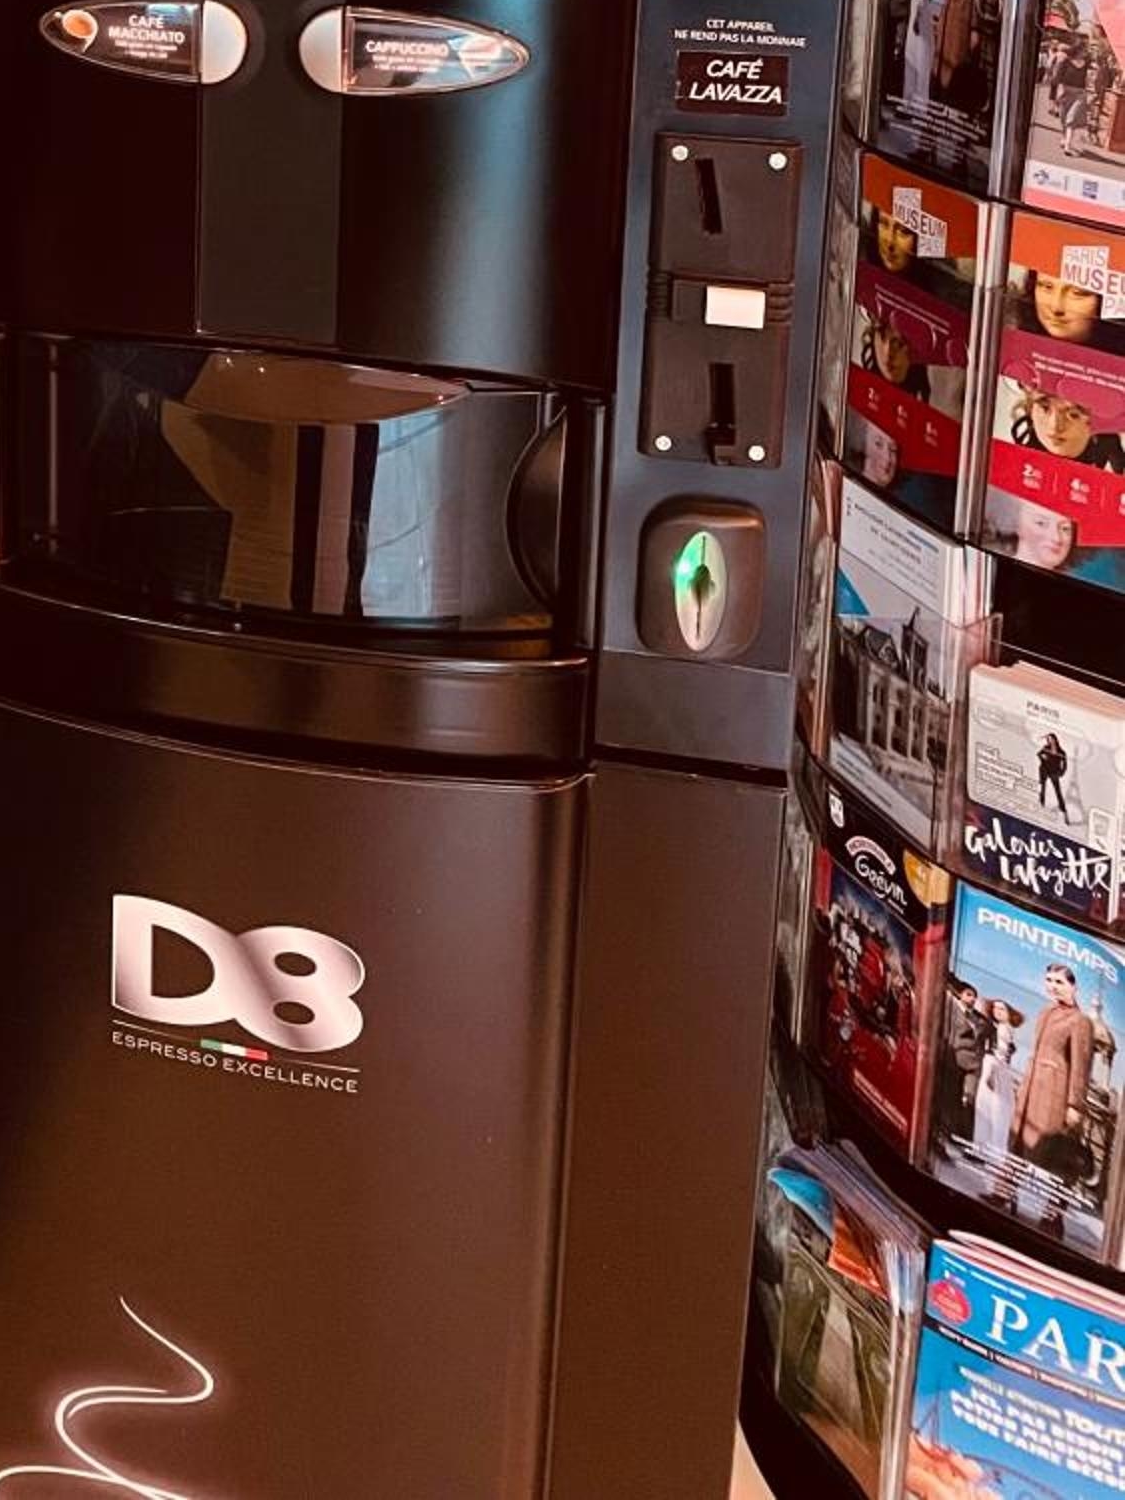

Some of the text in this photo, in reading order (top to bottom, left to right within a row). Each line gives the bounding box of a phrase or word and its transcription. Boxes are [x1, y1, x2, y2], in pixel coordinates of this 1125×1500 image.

[108, 25, 185, 45] MACCHIATO
[706, 19, 775, 32] CET APPAREIL
[675, 29, 807, 47] NE REND PAS LA MONNAIE
[366, 40, 449, 58] CAPPUCCINO
[706, 58, 764, 79] CAFÉ
[689, 81, 782, 104] LAVAZZA
[977, 907, 1119, 984] PRINTEMPS
[112, 894, 366, 1053] D8
[112, 1030, 358, 1094] ESPRESSO EXCELLENCE
